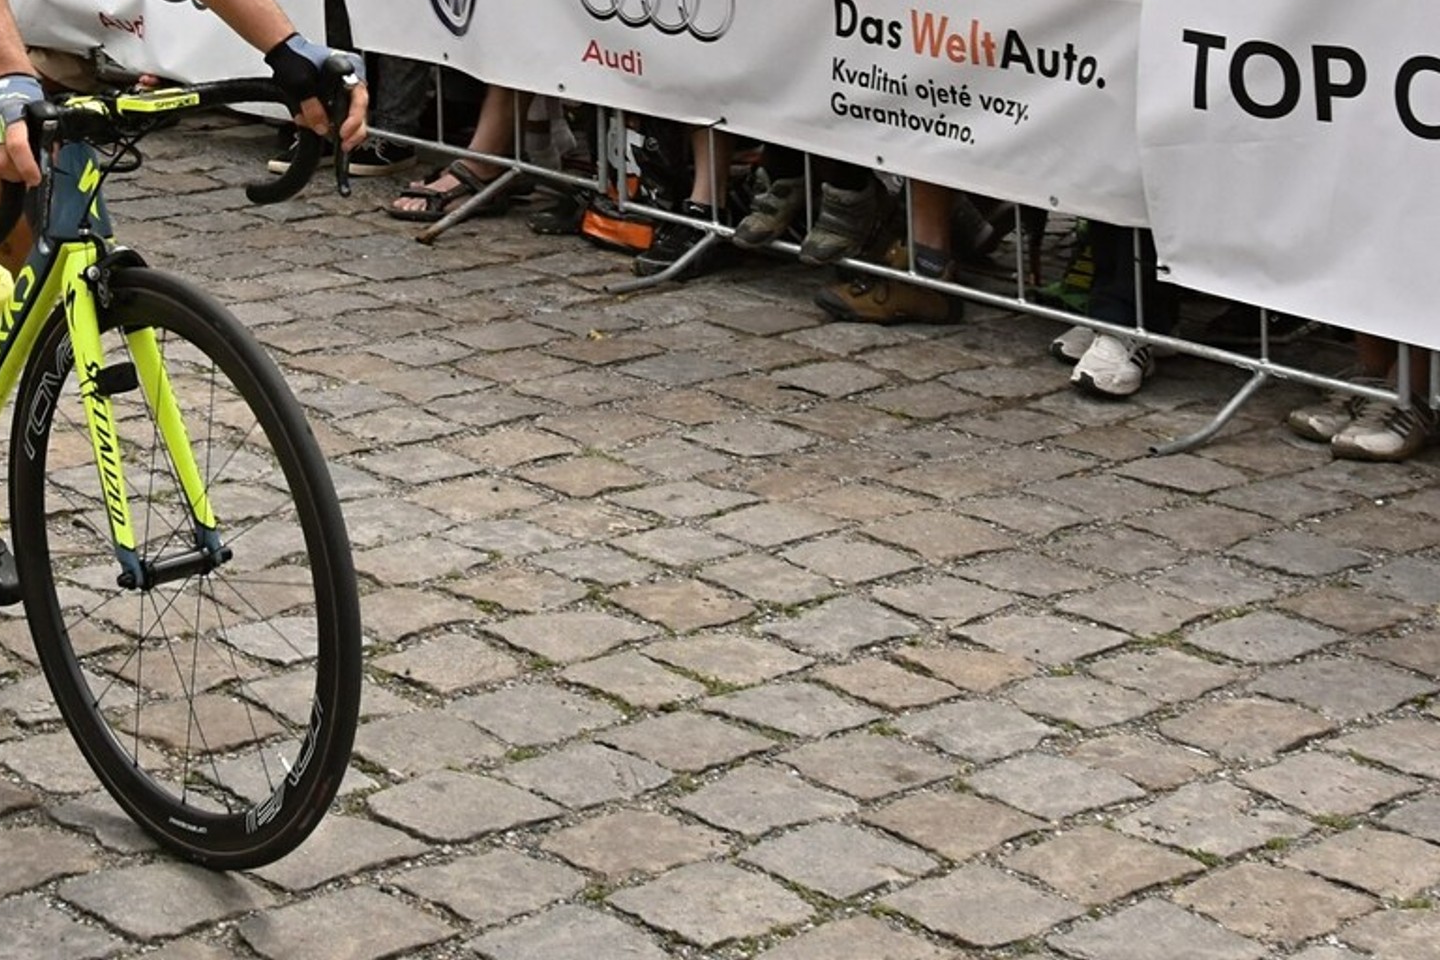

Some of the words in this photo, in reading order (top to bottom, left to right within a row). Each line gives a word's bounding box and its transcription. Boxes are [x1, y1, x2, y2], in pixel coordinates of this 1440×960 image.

[581, 39, 644, 76] Audi
[910, 9, 1107, 90] WeltAuto.
[1182, 28, 1367, 122] TOP
[830, 91, 976, 145] Garantováno.
[832, 56, 908, 97] Kvalitní
[915, 79, 973, 108] ojeté
[979, 93, 1029, 125] vozy.
